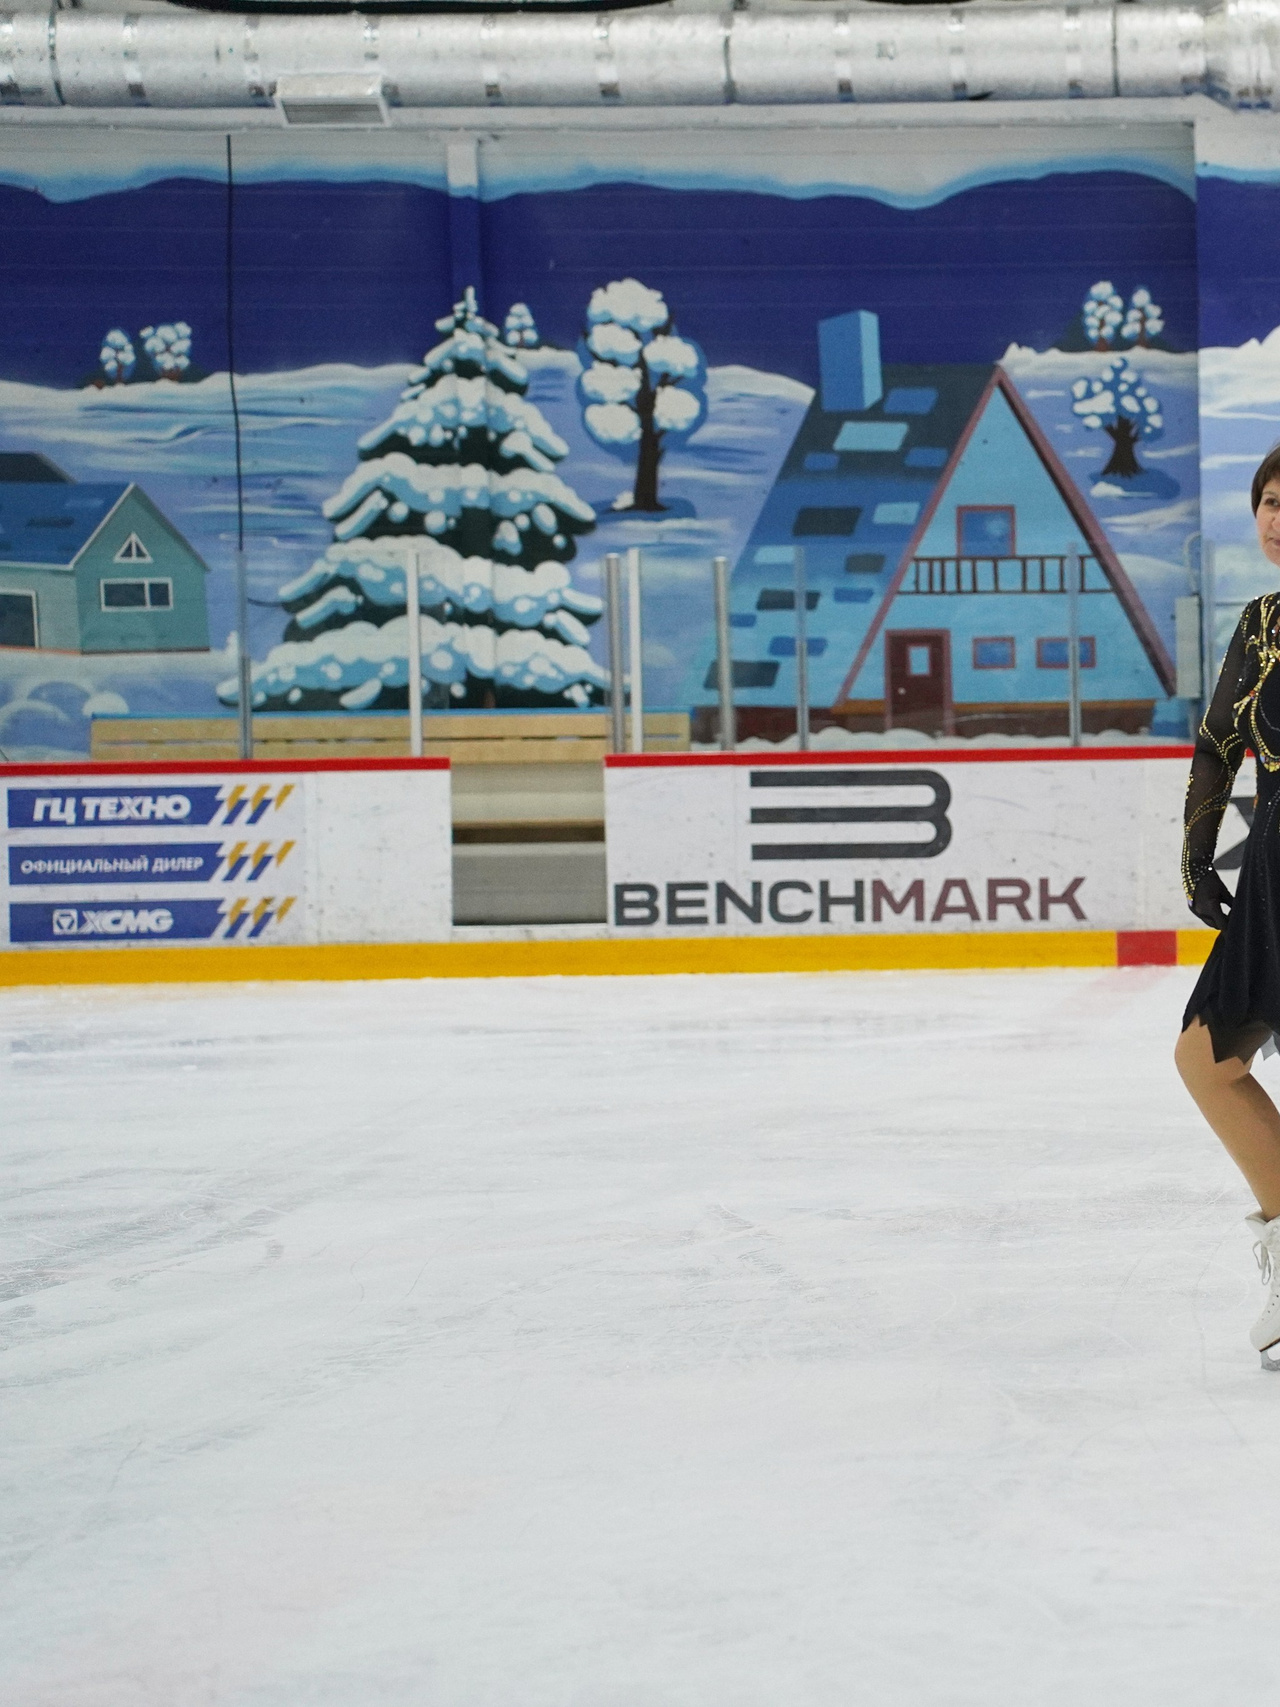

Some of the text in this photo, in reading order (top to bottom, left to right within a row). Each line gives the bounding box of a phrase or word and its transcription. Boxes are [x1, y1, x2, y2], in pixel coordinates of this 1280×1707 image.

[33, 795, 191, 824] ГЦ ТЕХНО
[20, 855, 203, 875] ОФИЦИАЛЬНЫЙ ДИЛЕР
[614, 877, 1088, 926] BENCHMARK
[79, 909, 174, 933] XCMG
